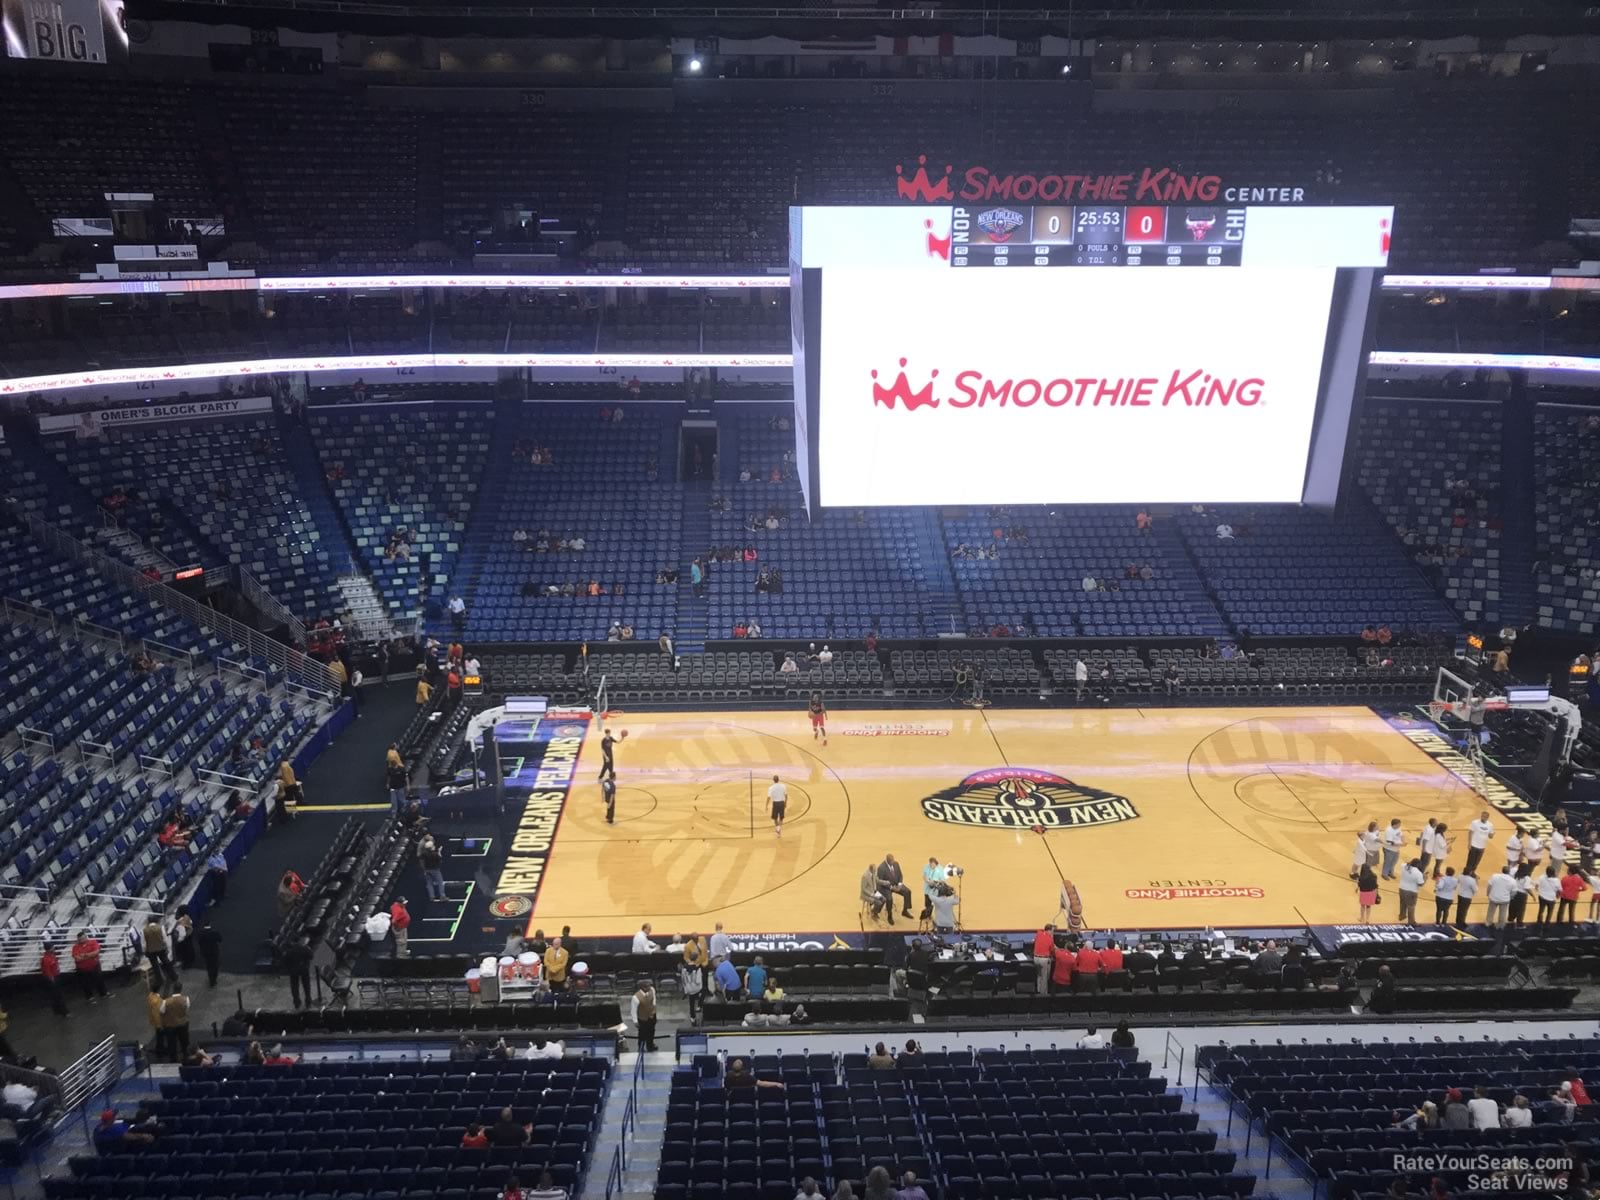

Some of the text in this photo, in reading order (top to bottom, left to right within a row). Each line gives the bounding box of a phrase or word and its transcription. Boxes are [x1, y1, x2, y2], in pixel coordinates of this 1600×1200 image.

[35, 21, 98, 60] BIG.
[521, 94, 544, 105] 330
[872, 85, 893, 96] 332
[960, 166, 1133, 201] SMOOTHIE
[1224, 187, 1305, 203] CENTER
[953, 207, 970, 242] NOP
[977, 211, 1024, 225] NEW ORLEANS
[1048, 216, 1060, 233] 0
[1079, 212, 1120, 225] 25:53
[1141, 216, 1152, 233] 0
[1225, 210, 1245, 240] CHI
[948, 370, 1159, 408] SMOOTHIE
[100, 401, 239, 421] OMER'S BLOCK PARTY
[533, 736, 582, 790] PELICANS
[510, 791, 565, 853] ORLEANS
[923, 798, 1136, 826] NEW ORLEANS
[495, 857, 546, 896] NEW
[1149, 879, 1227, 888] CENTER
[1173, 888, 1262, 898] SMOOTHIE
